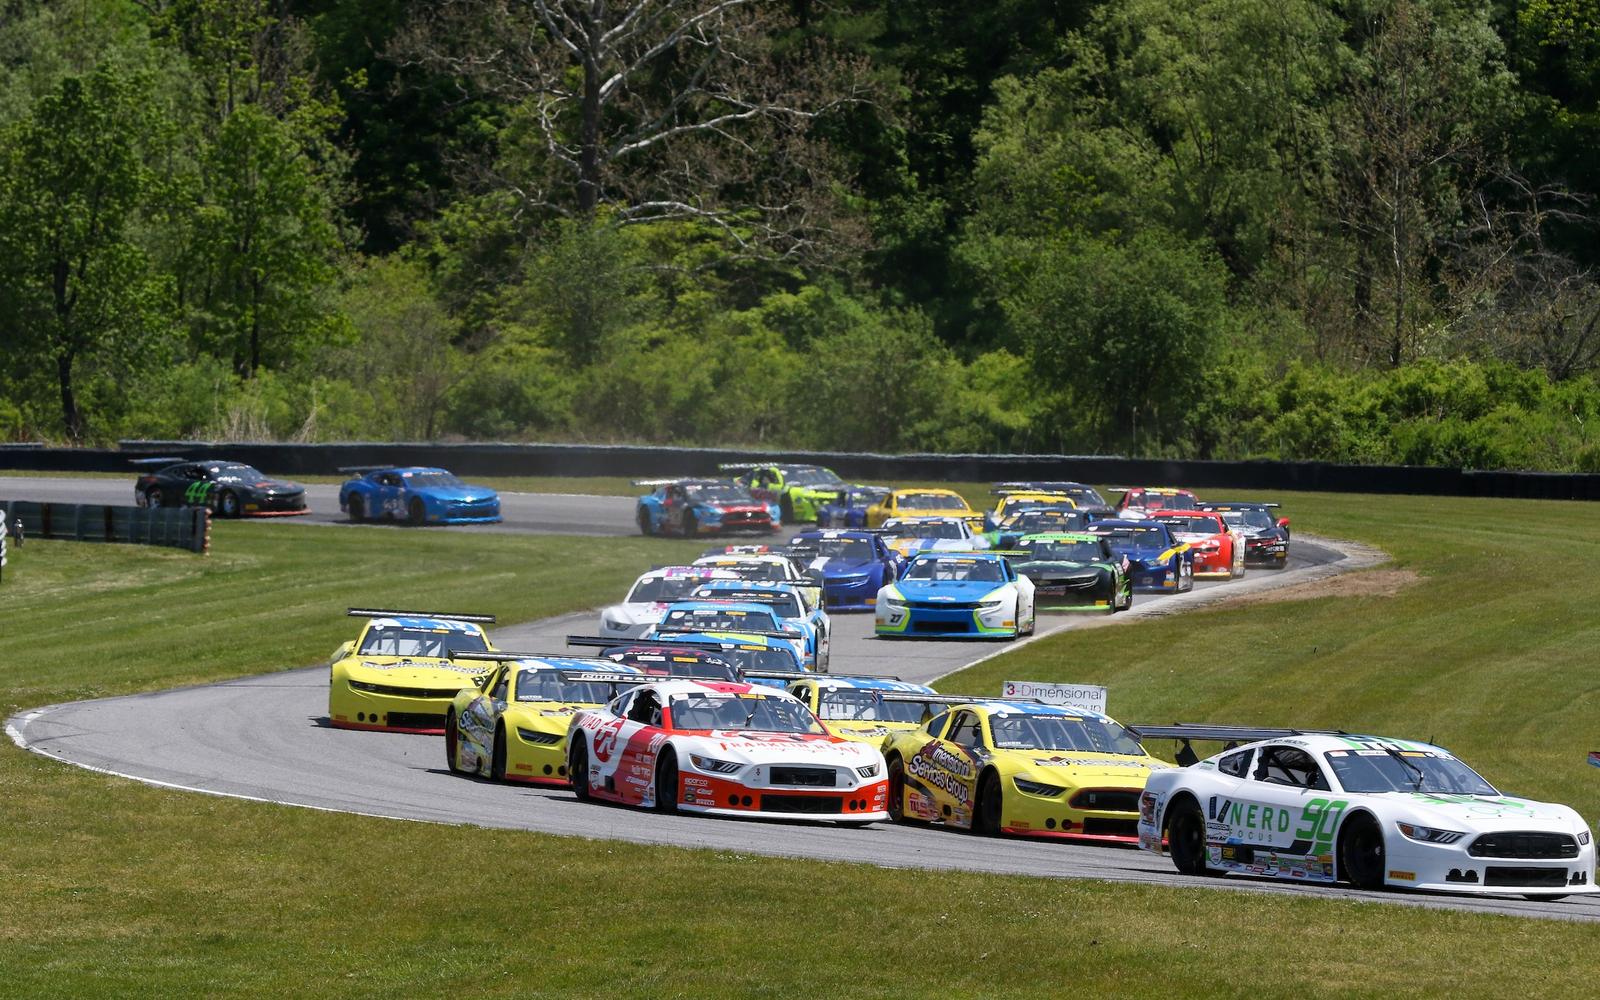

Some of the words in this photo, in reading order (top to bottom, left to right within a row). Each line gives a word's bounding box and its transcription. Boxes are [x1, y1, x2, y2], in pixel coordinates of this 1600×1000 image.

[184, 481, 213, 504] 44
[890, 614, 901, 623] 27
[1006, 683, 1102, 700] 3-Dimensional
[908, 754, 946, 788] Services
[945, 773, 968, 805] Group
[1229, 802, 1290, 833] NERD
[1297, 799, 1349, 841] 90
